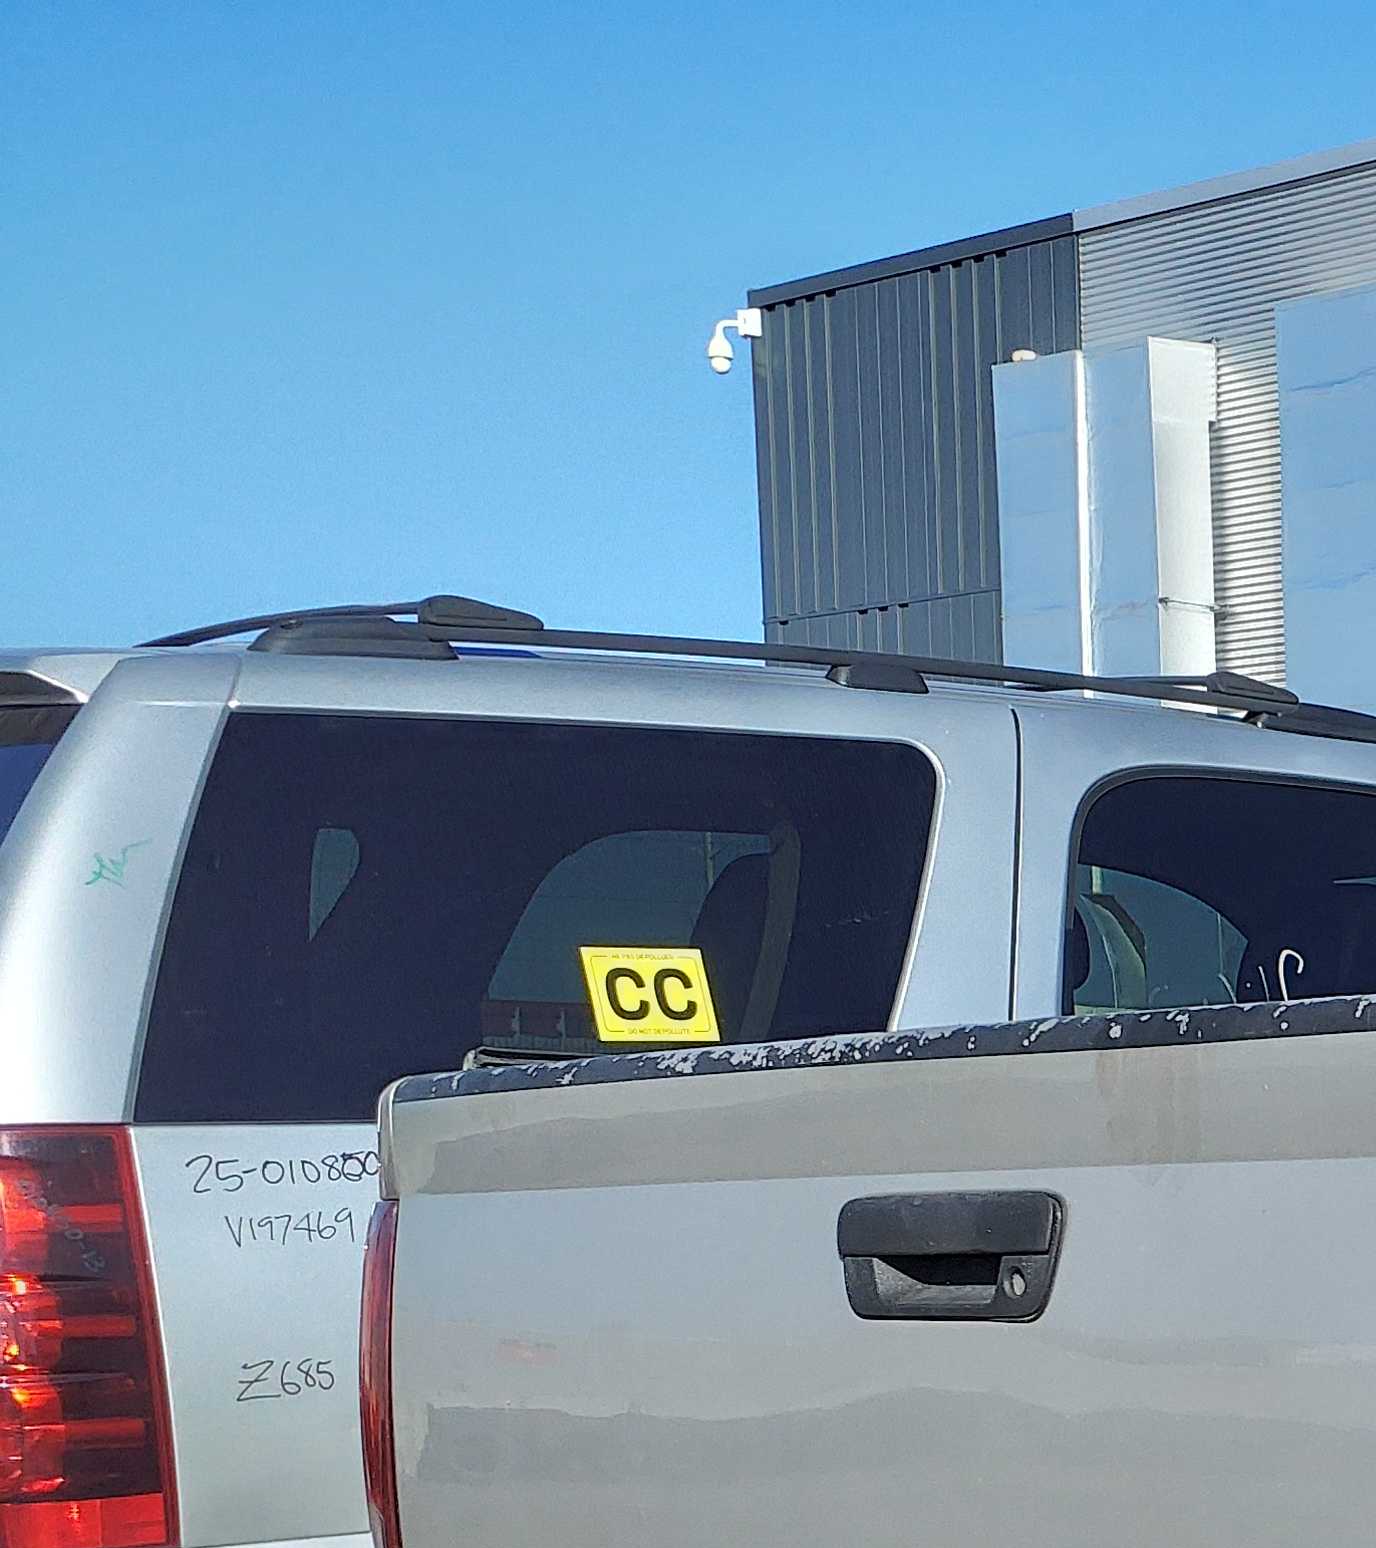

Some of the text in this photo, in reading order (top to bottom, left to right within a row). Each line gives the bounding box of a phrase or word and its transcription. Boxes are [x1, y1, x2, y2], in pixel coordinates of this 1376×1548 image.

[605, 967, 698, 1021] CC
[224, 1207, 356, 1248] V197469
[235, 1357, 336, 1402] Z685
